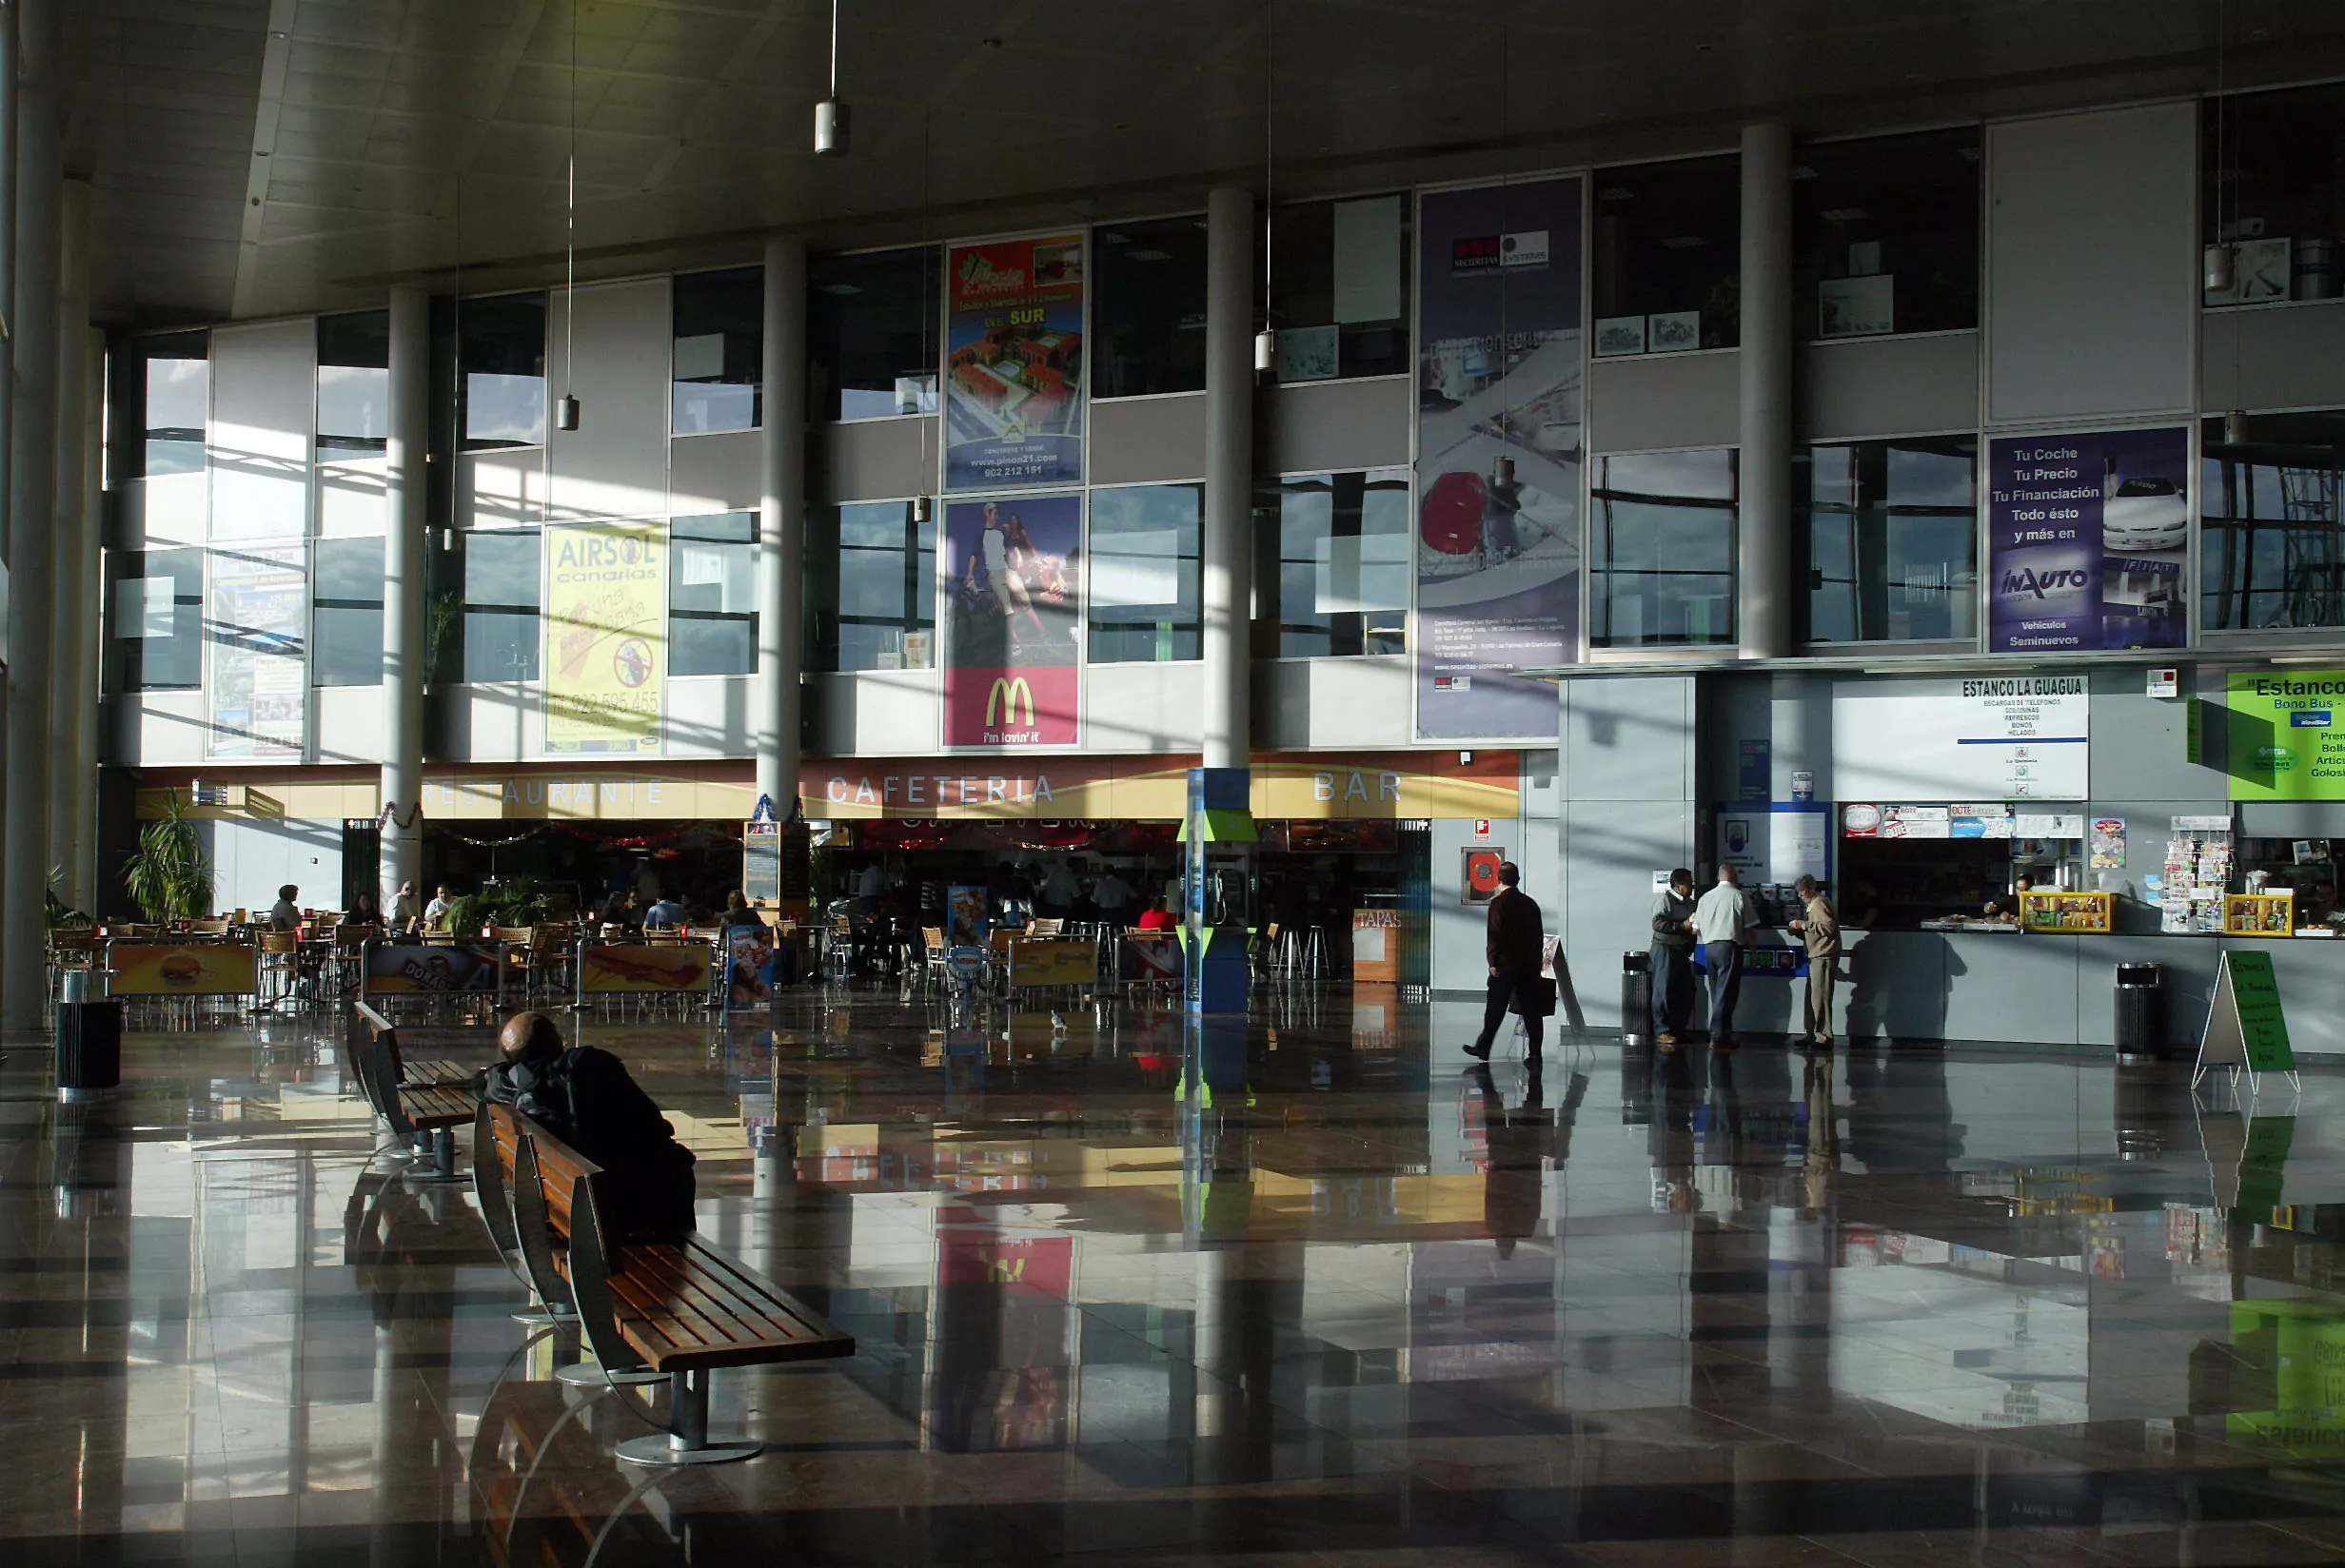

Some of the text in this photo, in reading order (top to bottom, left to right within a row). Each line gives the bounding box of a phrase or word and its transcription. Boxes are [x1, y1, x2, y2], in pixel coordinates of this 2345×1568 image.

[1010, 308, 1045, 325] SUR
[2014, 447, 2078, 461] Tu Coche
[1005, 466, 1022, 476] 212
[2014, 467, 2078, 480] Tu Precio
[1992, 485, 2099, 501] Tu Financiación
[2012, 509, 2045, 520] Todo
[2014, 528, 2076, 543] y más en
[557, 568, 657, 583] canarias
[2009, 636, 2079, 647] Seminuevos
[1962, 677, 2082, 697] ESTANCO LA GUAGUA
[632, 691, 659, 713] 455
[2274, 698, 2307, 709] Bono
[2310, 698, 2334, 708] Bus
[983, 732, 1039, 743] i'm lovin' it
[422, 778, 663, 805] RESTAURANTE
[827, 775, 1054, 804] CAFETERIA
[1314, 772, 1403, 802] BAR
[1952, 806, 1972, 814] BOTE
[1358, 911, 1402, 928] TAPAS
